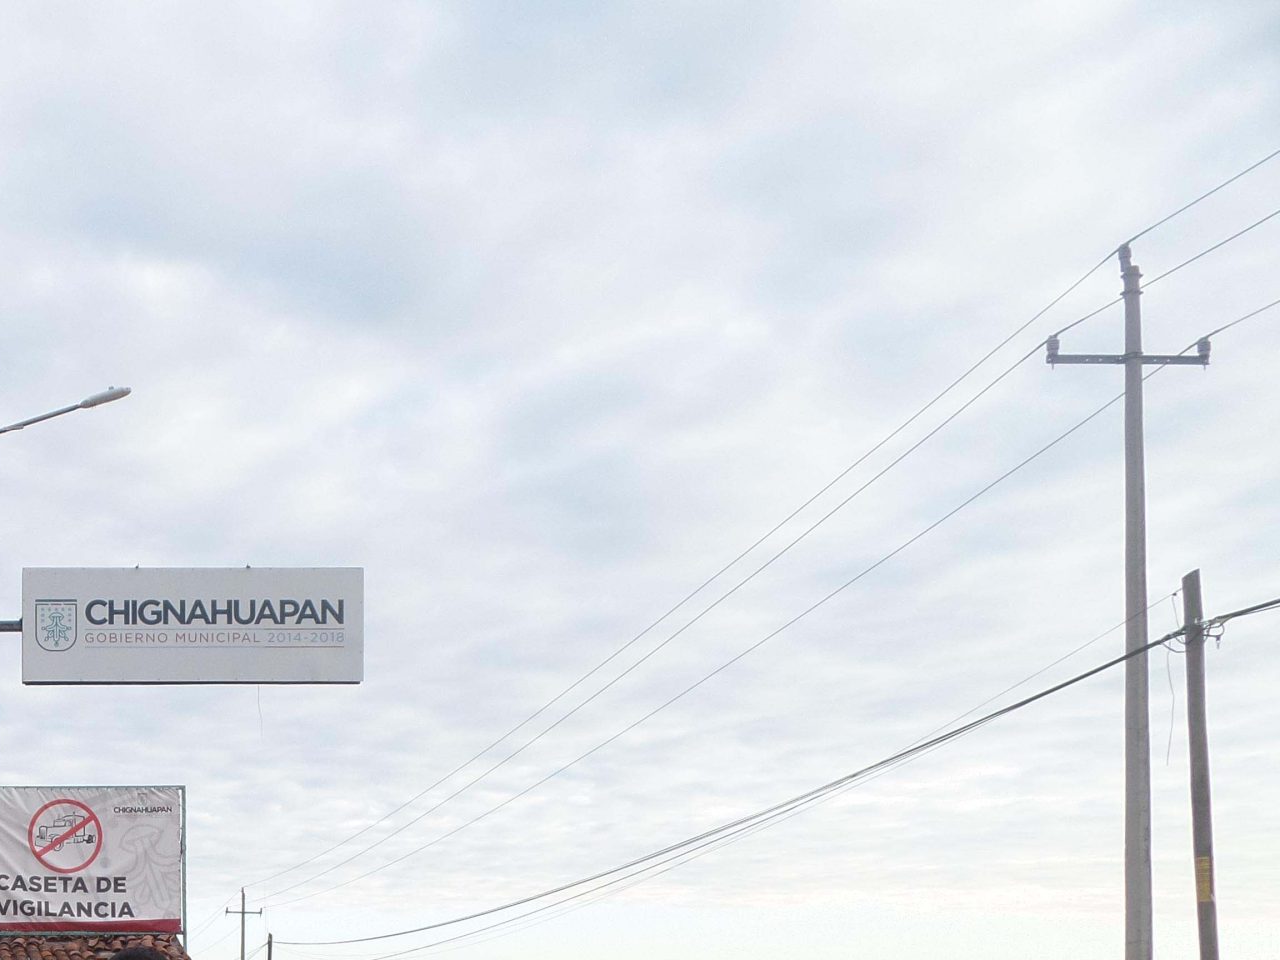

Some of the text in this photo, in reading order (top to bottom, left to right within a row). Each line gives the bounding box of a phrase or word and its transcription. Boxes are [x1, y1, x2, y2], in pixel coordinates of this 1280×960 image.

[85, 599, 344, 626] CHIGNAHUAPAN
[84, 632, 345, 644] GOBIERNO MUNICIPAL 2014-2018
[113, 806, 172, 814] CHIGNAHUAPAN
[96, 876, 127, 893] DE
